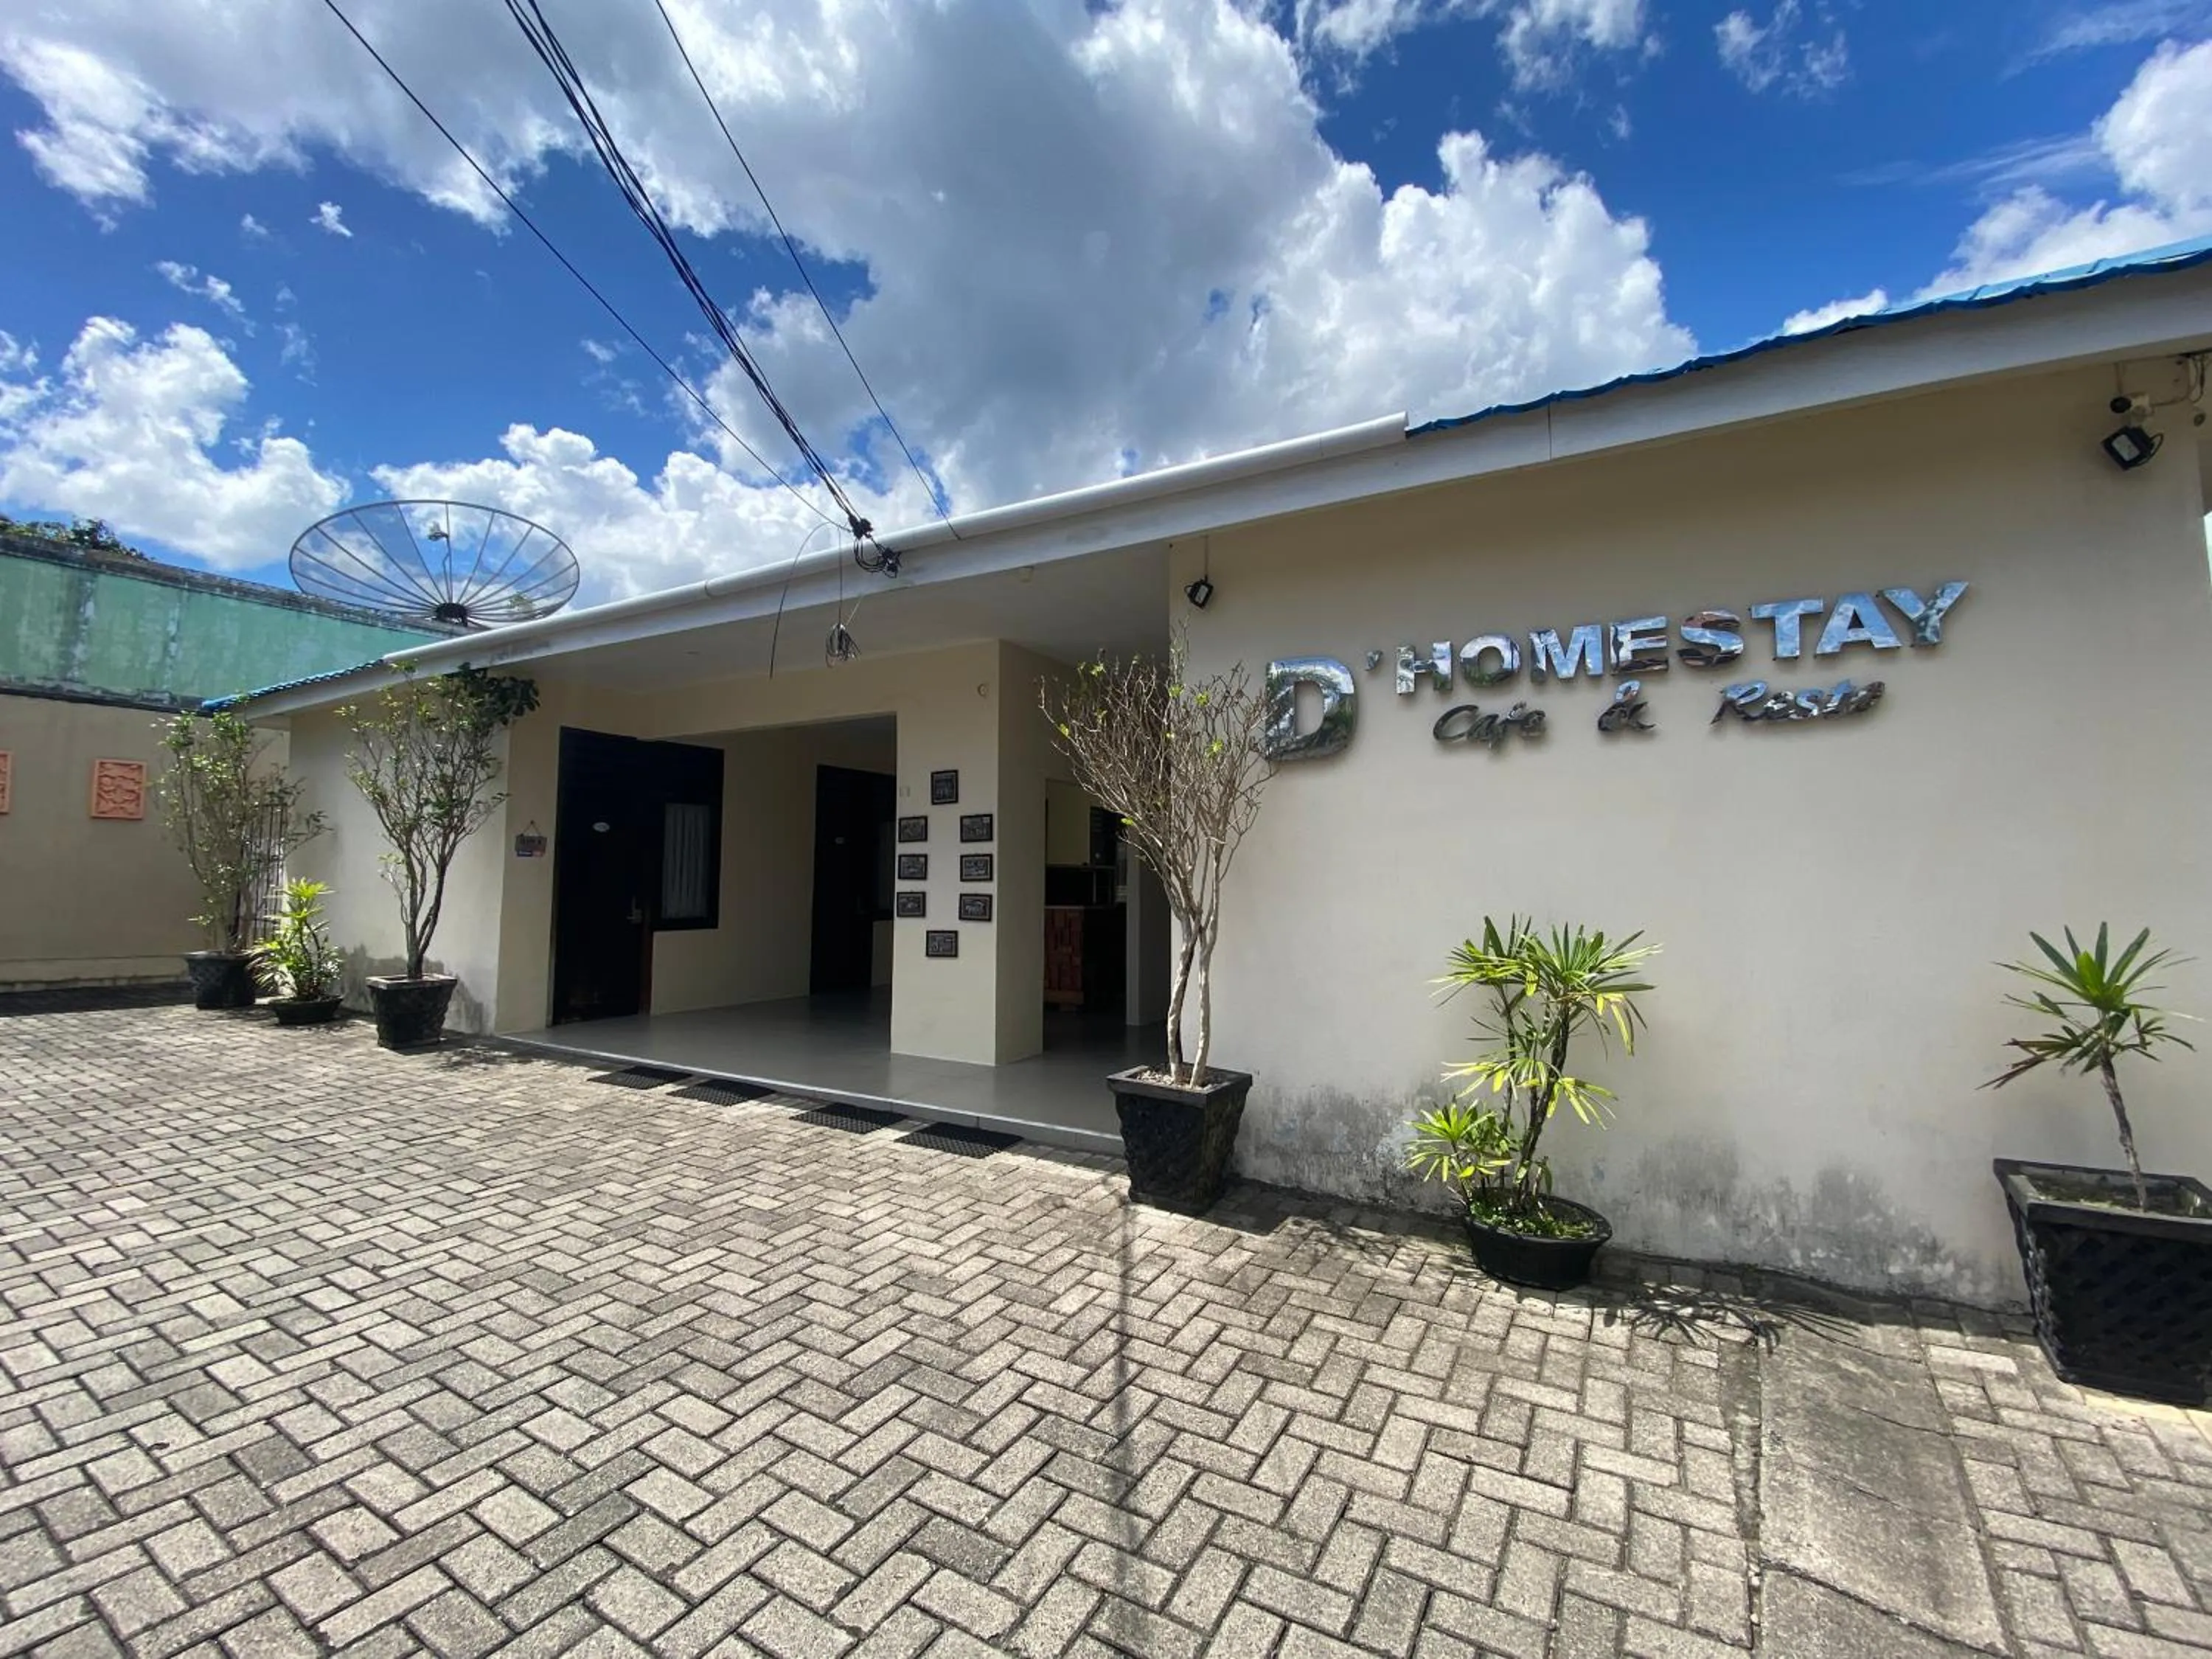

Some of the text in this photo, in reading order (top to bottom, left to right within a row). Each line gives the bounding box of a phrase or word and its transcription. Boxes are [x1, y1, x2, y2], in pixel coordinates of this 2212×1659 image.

[1265, 580, 1969, 761] D'HOMESTAY
[1432, 678, 1885, 751] Cafe & Resto
